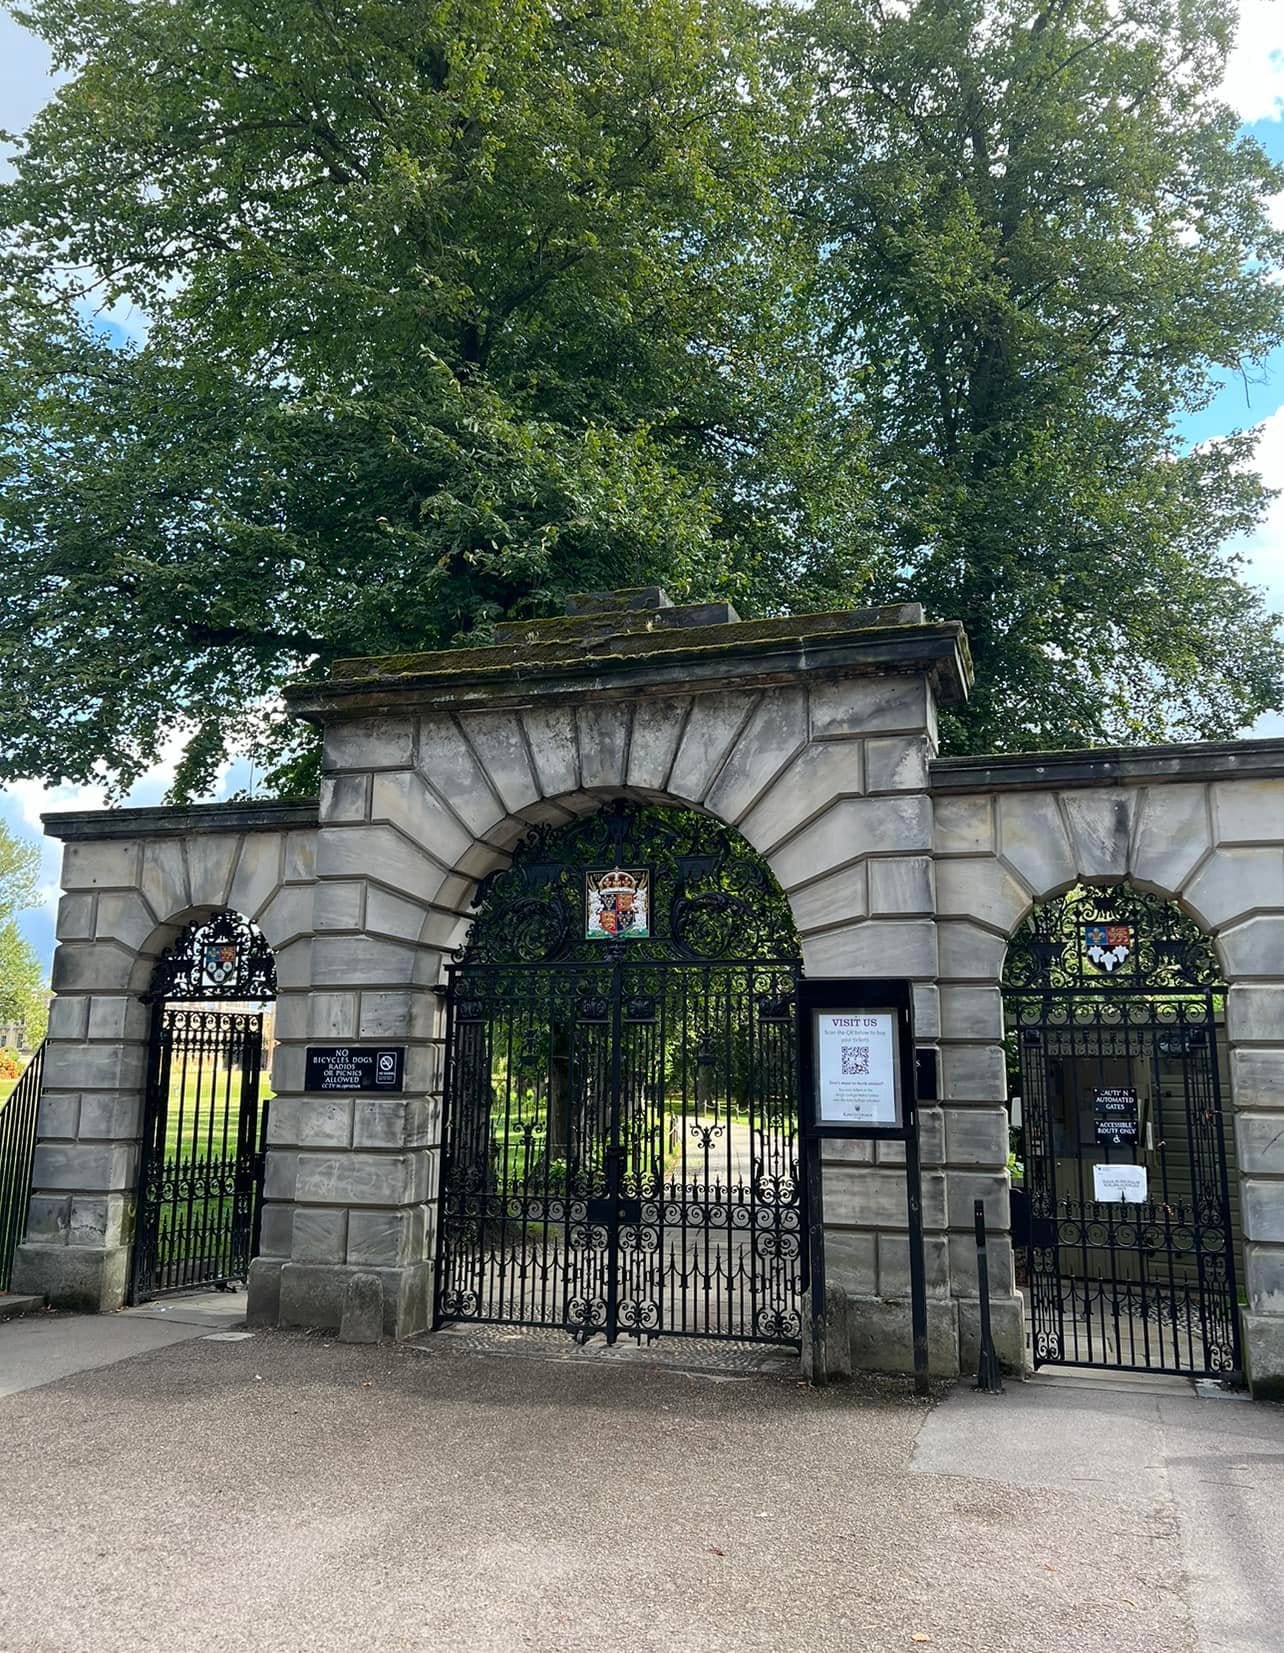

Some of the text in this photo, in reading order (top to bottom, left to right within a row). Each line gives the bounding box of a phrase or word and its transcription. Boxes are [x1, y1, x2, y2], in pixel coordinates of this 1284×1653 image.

[832, 1018, 878, 1027] VISIT US
[335, 1049, 349, 1057] NO
[313, 1056, 349, 1064] BICYCLES
